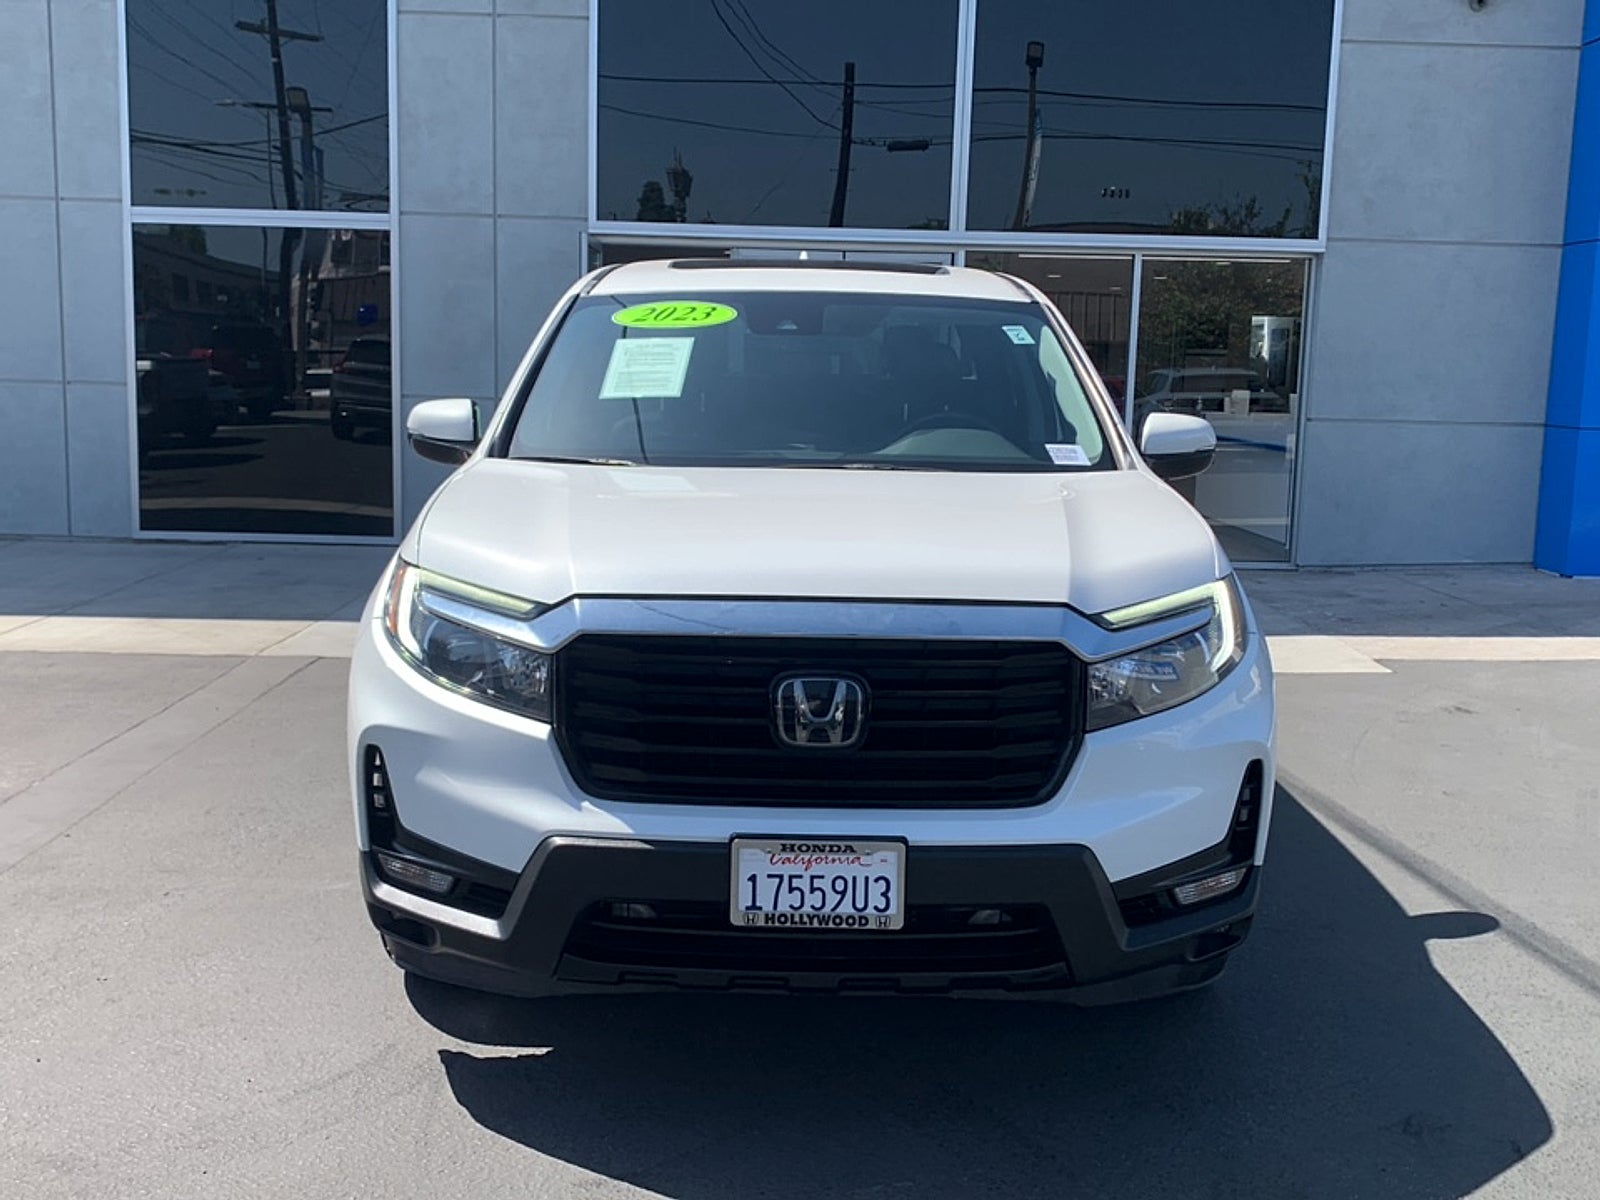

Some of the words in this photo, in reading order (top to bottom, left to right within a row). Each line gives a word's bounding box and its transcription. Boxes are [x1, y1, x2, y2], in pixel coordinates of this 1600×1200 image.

[631, 306, 717, 323] 2023
[779, 843, 858, 854] HONDA
[769, 853, 873, 872] California
[745, 873, 892, 913] 17559U3
[764, 913, 870, 927] HOLLYWOOD
